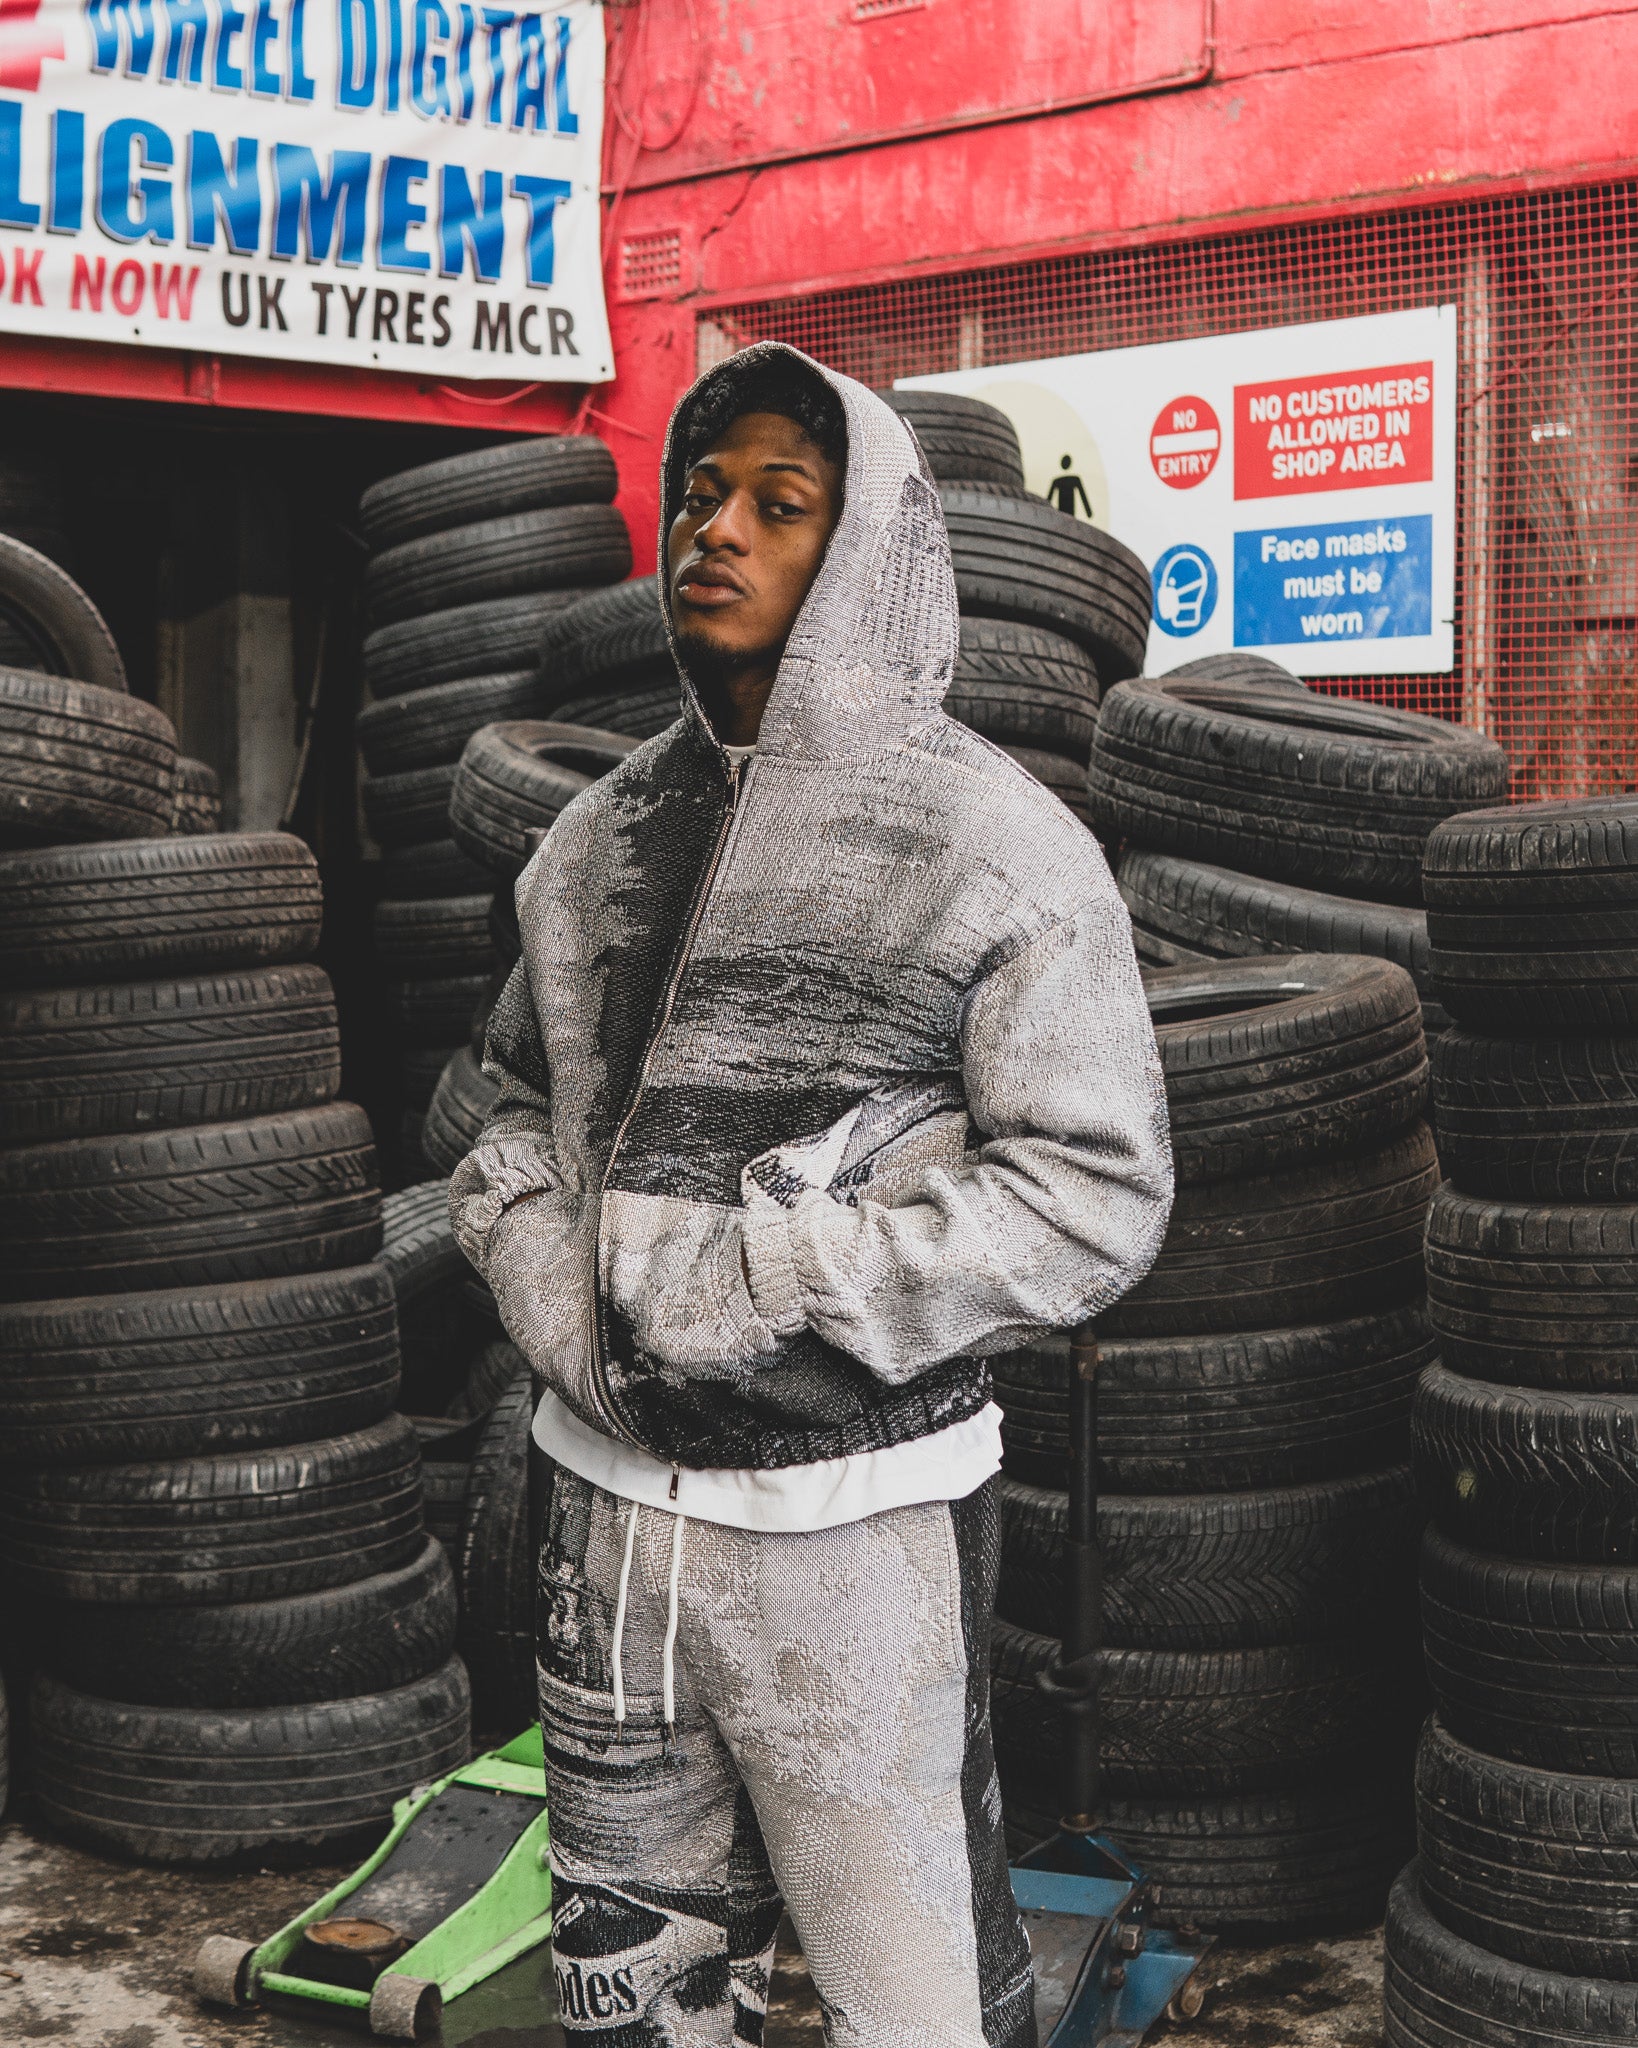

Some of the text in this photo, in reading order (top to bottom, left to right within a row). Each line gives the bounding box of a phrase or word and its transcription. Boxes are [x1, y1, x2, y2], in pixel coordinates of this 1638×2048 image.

[84, 0, 579, 137] WHEEL DIGITAL
[0, 99, 572, 290] LIGNMENT
[70, 253, 201, 321] NOW
[221, 271, 290, 332] UK
[311, 281, 452, 347] TYRES
[473, 300, 580, 356] MCR
[1249, 375, 1430, 423] NO CUSTOMERS
[1172, 409, 1198, 431] NO
[1267, 409, 1410, 451] ALLOWED IN
[1158, 453, 1212, 479] ENTRY
[1272, 441, 1406, 481] SHOP AREA
[1261, 526, 1407, 563] Face masks
[1284, 567, 1382, 600] must be
[1301, 608, 1364, 637] worn
